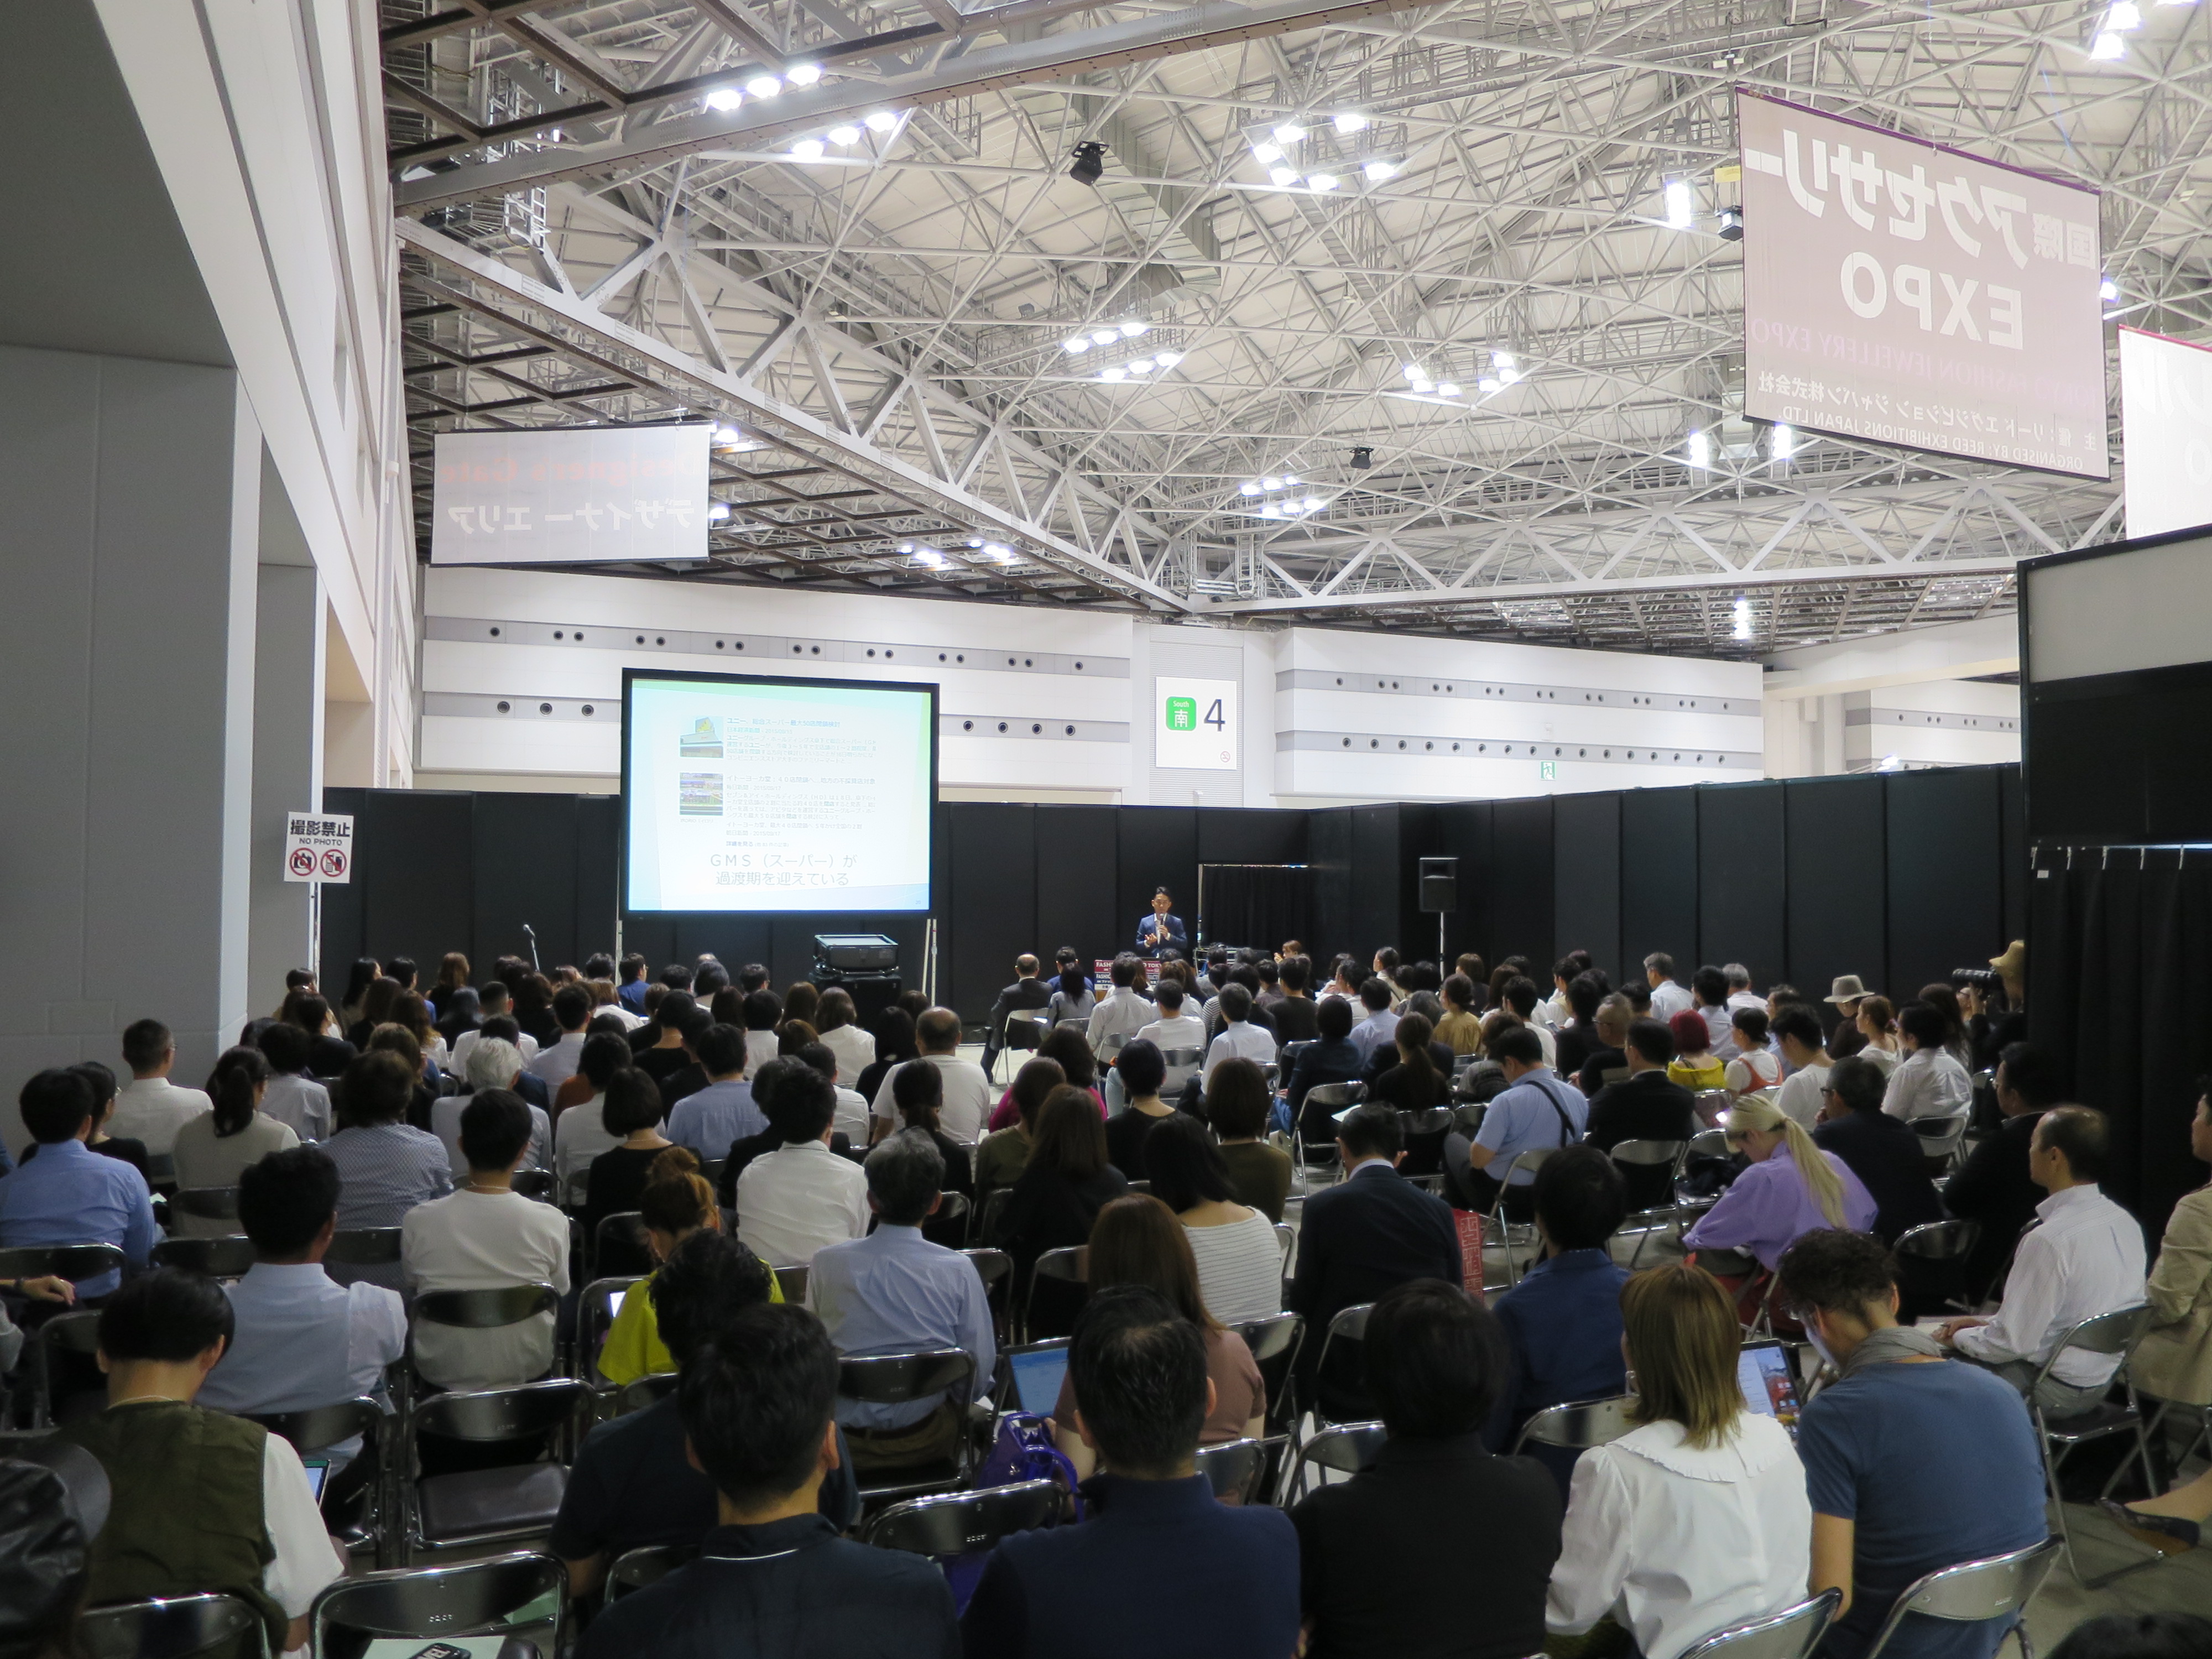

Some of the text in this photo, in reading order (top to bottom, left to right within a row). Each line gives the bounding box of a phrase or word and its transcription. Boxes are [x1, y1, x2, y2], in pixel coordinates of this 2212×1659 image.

[1175, 709, 1188, 727] 南
[1204, 699, 1225, 731] 4
[291, 820, 350, 837] 撮影禁止
[716, 872, 849, 886] 過渡期を迎えている
